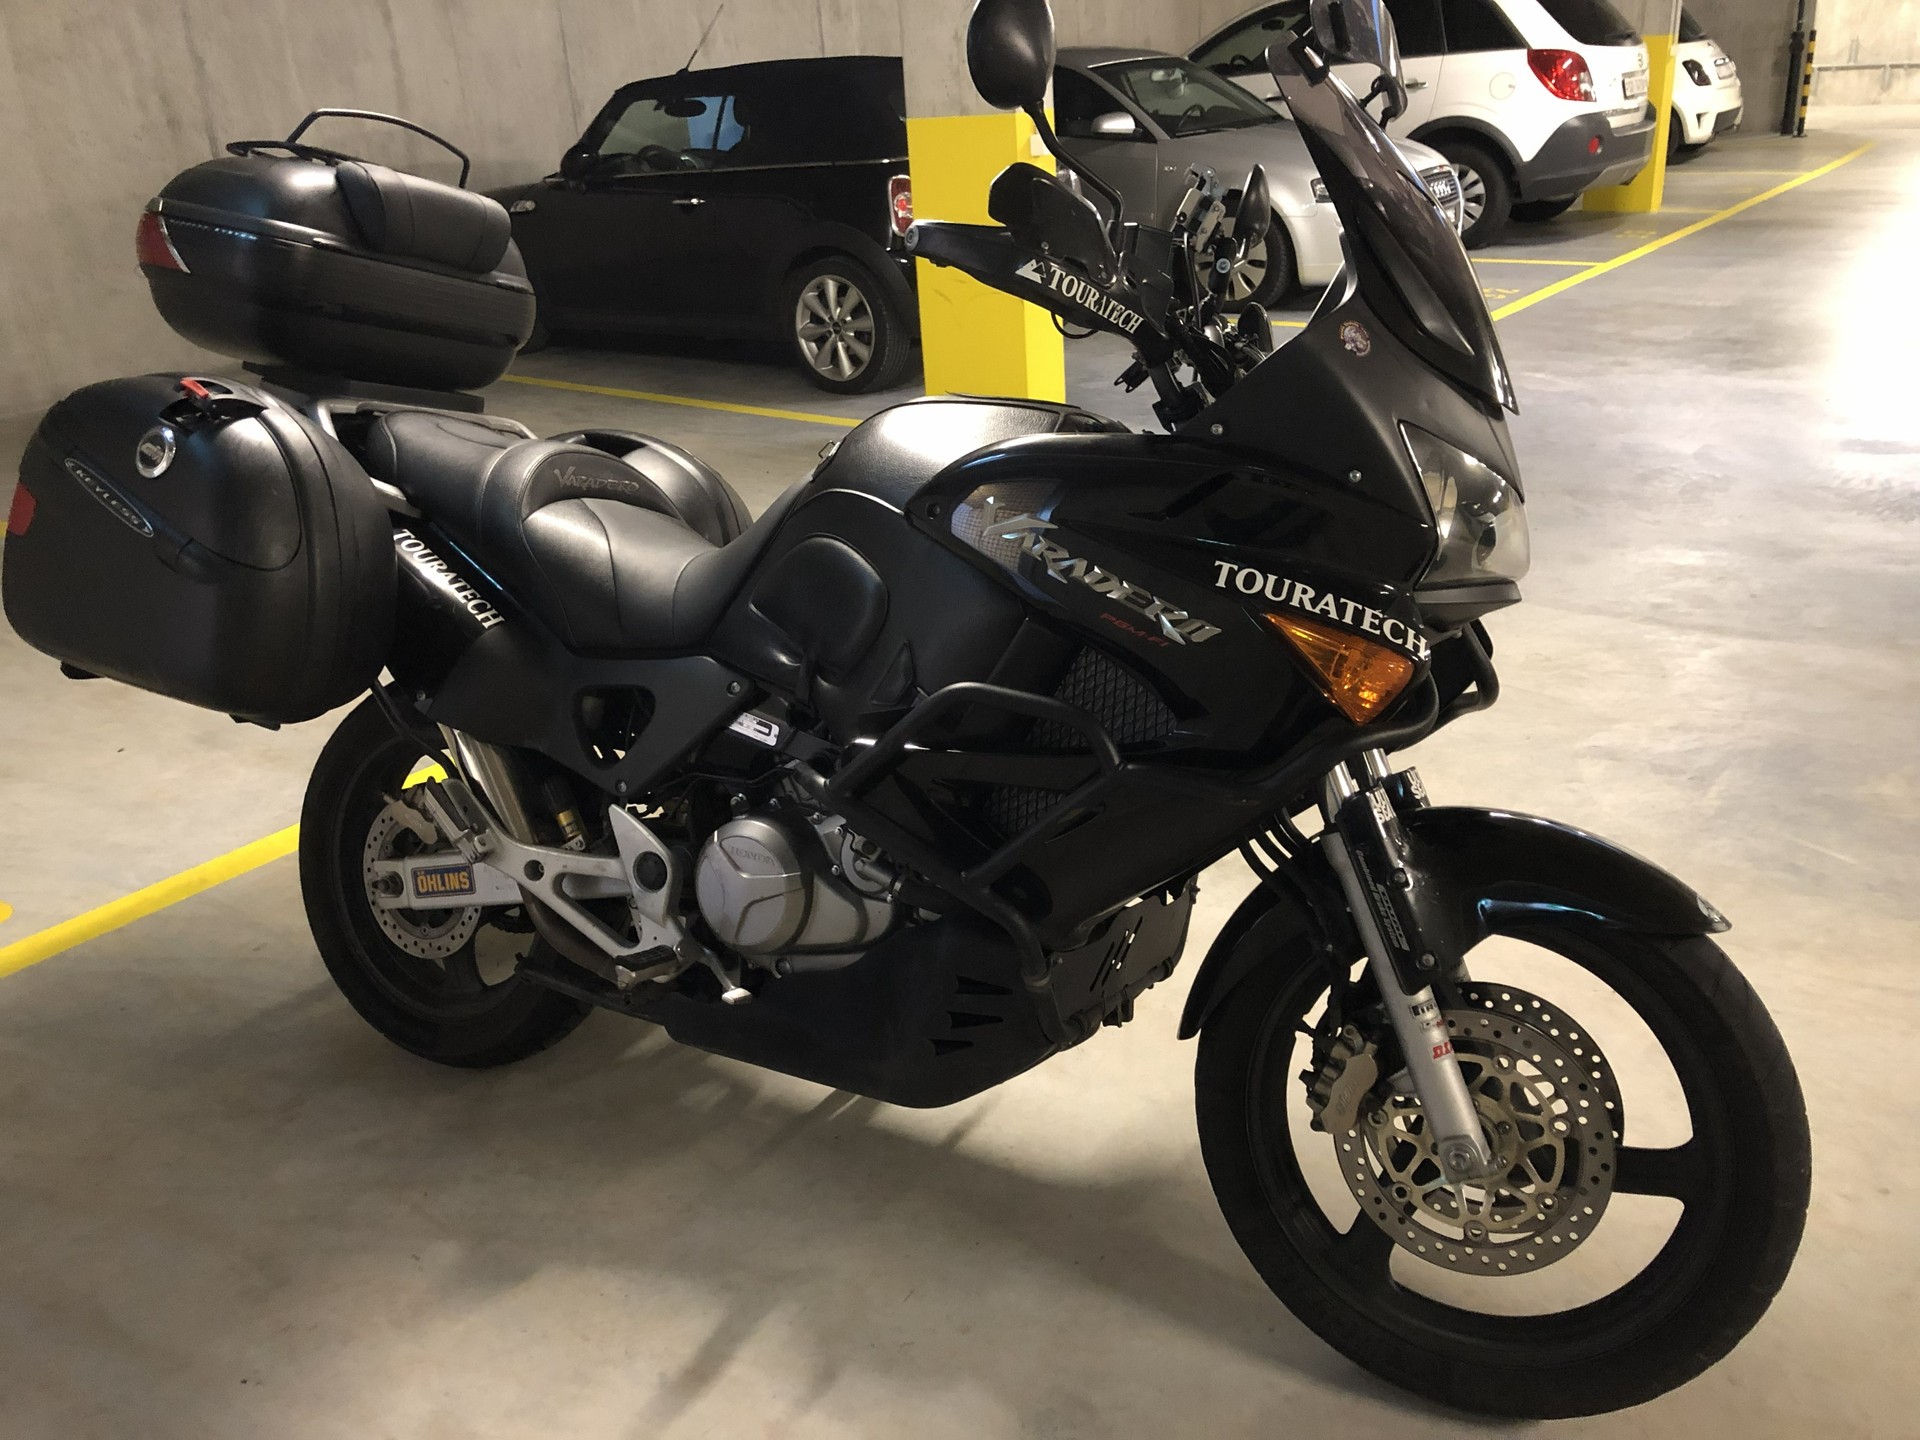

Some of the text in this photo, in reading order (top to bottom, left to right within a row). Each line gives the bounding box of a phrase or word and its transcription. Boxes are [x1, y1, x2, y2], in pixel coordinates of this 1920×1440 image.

[1048, 266, 1144, 334] TOURATECH
[553, 465, 640, 494] VARADERO
[393, 528, 506, 630] TOURATECH
[983, 496, 1222, 646] VARADERO
[1100, 612, 1169, 648] PGM-FI
[1214, 560, 1430, 661] TOURATECH
[417, 871, 471, 893] ÖHLINS
